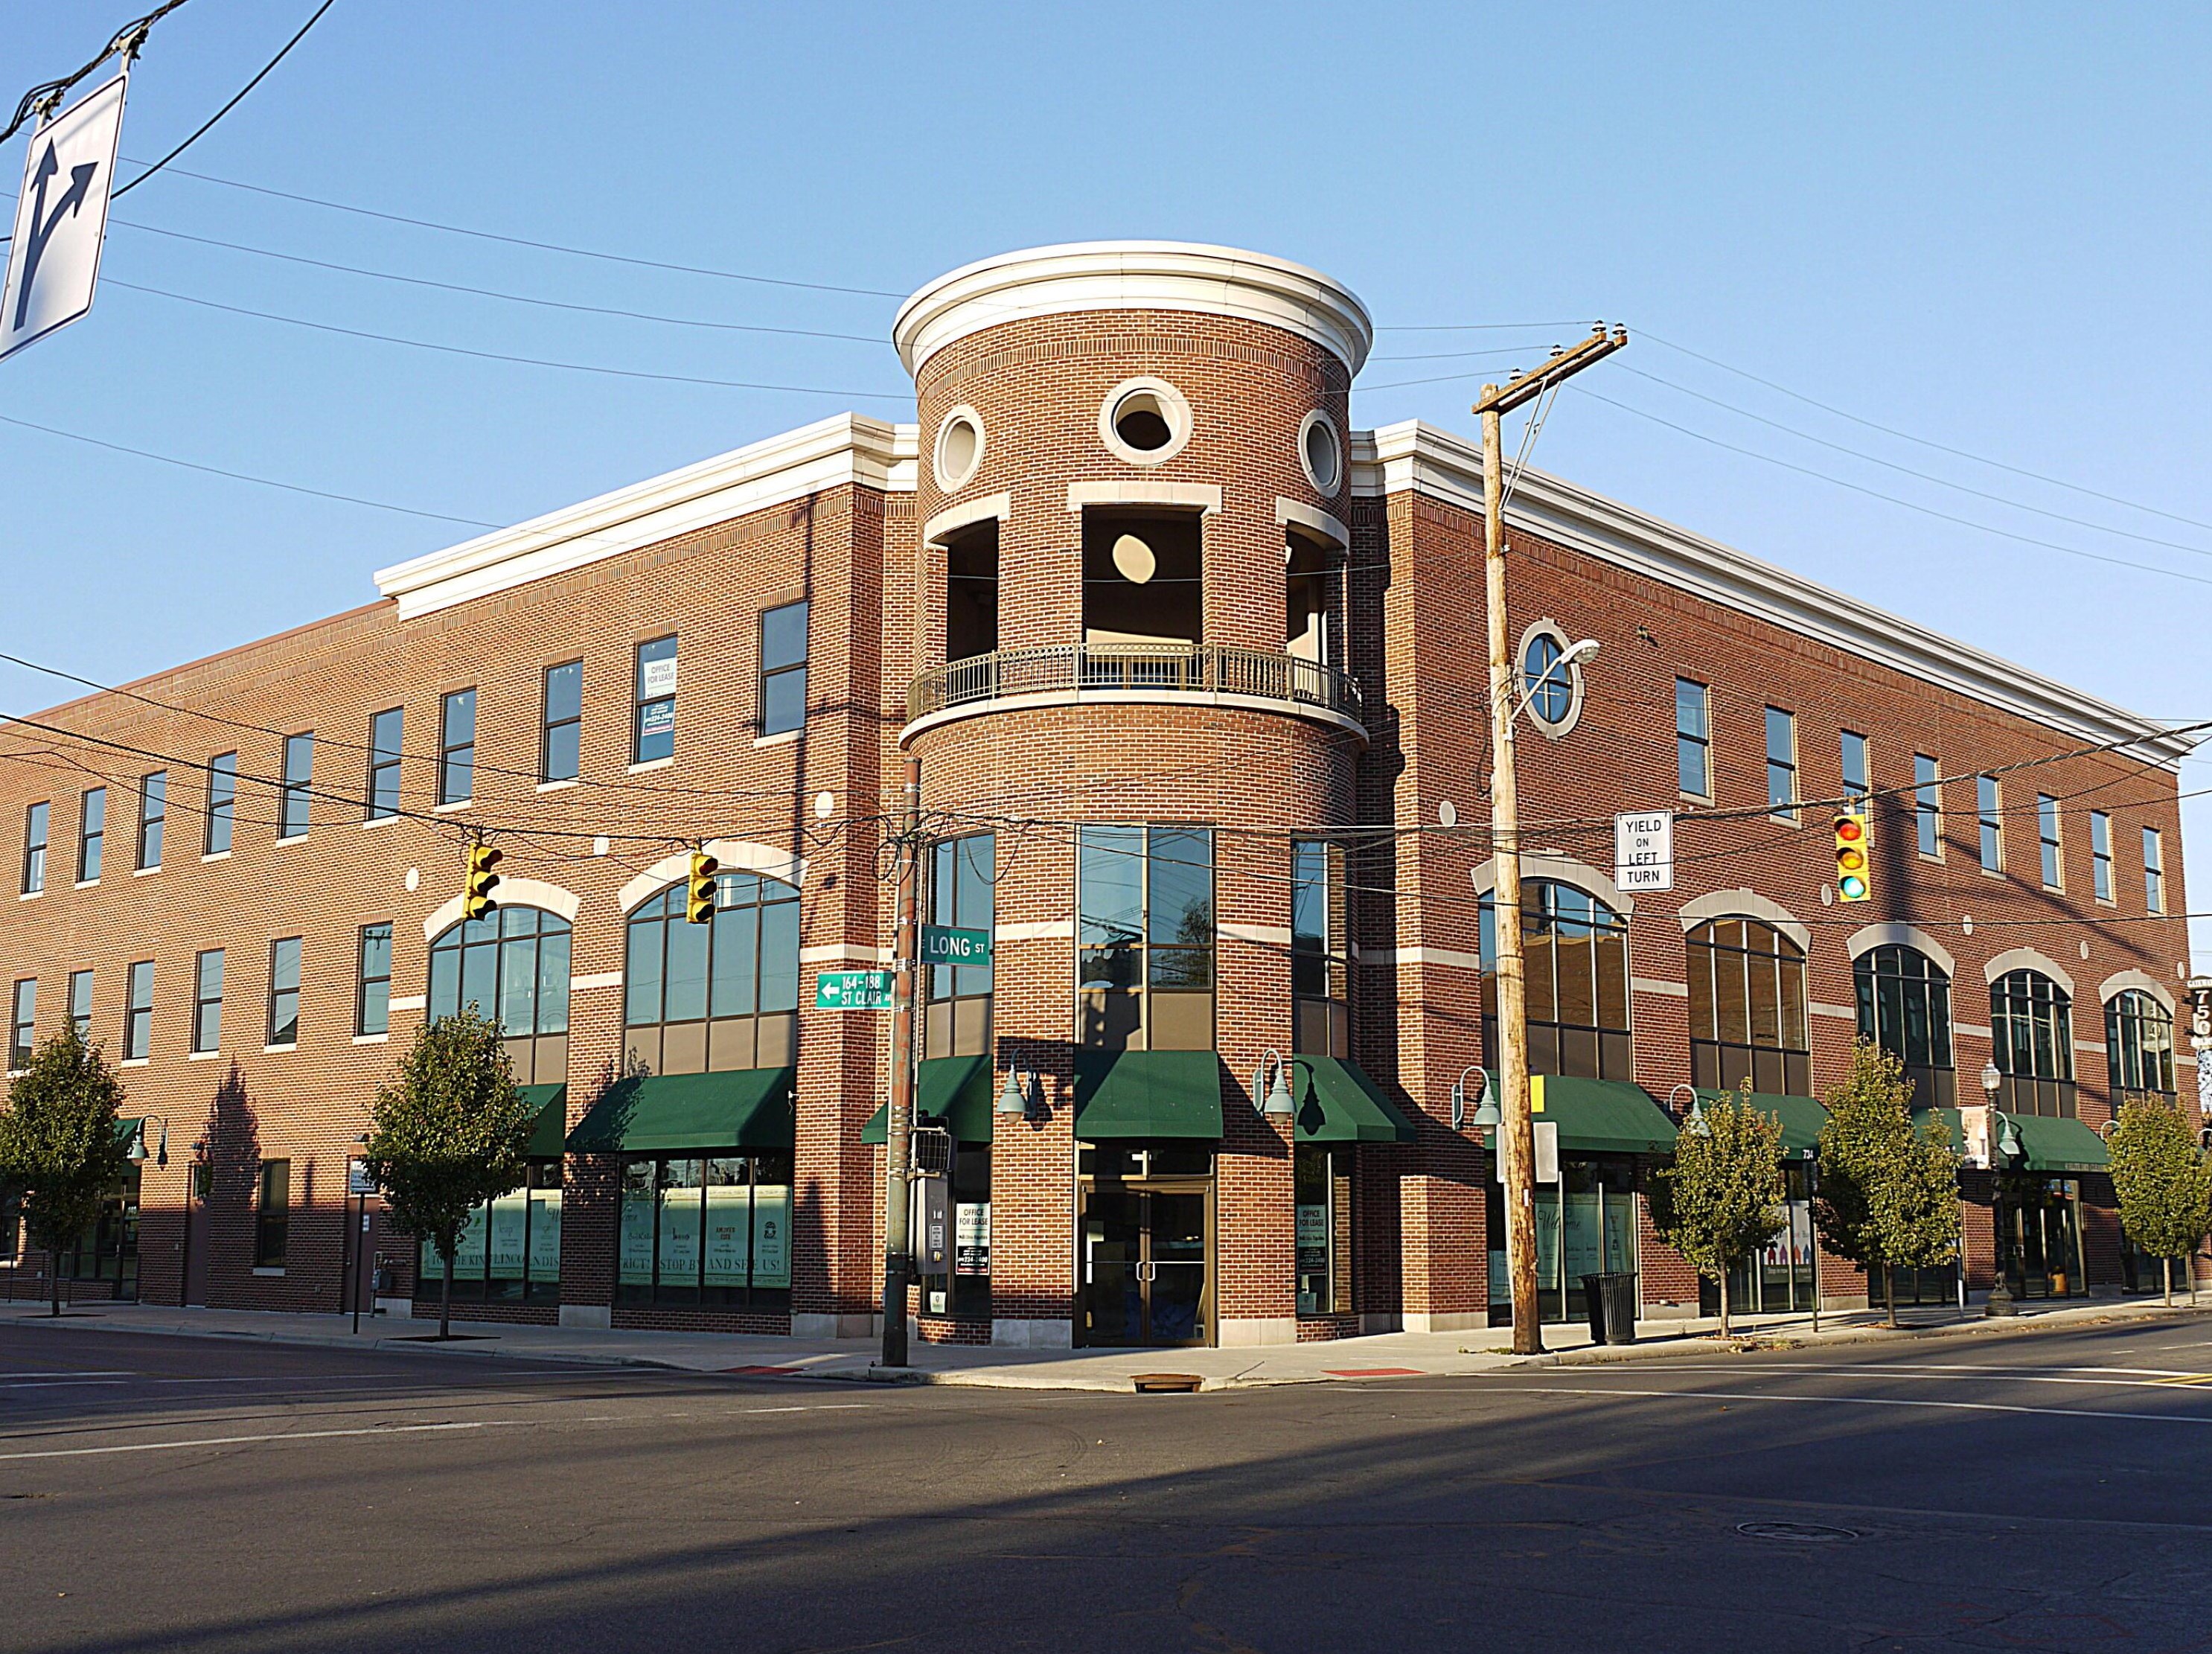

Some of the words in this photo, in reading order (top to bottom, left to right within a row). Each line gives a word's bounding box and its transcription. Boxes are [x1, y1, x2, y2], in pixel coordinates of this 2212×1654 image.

[651, 663, 671, 674] OFFICE
[647, 674, 658, 685] FOR
[658, 671, 674, 683] LEASE
[1626, 820, 1661, 833] YIELD
[1636, 838, 1649, 847] ON
[1628, 852, 1658, 865] LEFT
[1627, 870, 1660, 883] TURN
[930, 935, 971, 957] LONG
[975, 943, 985, 953] ST
[842, 975, 880, 990] 164-188
[841, 992, 851, 1005] ST
[855, 991, 882, 1005] CLAIR
[1803, 1149, 1814, 1160] 734
[963, 1208, 984, 1216] OFFICE
[1302, 1210, 1320, 1218] OFFICE
[971, 1217, 988, 1225] LEASE
[659, 1258, 686, 1271] STOP
[708, 1258, 732, 1271] AND
